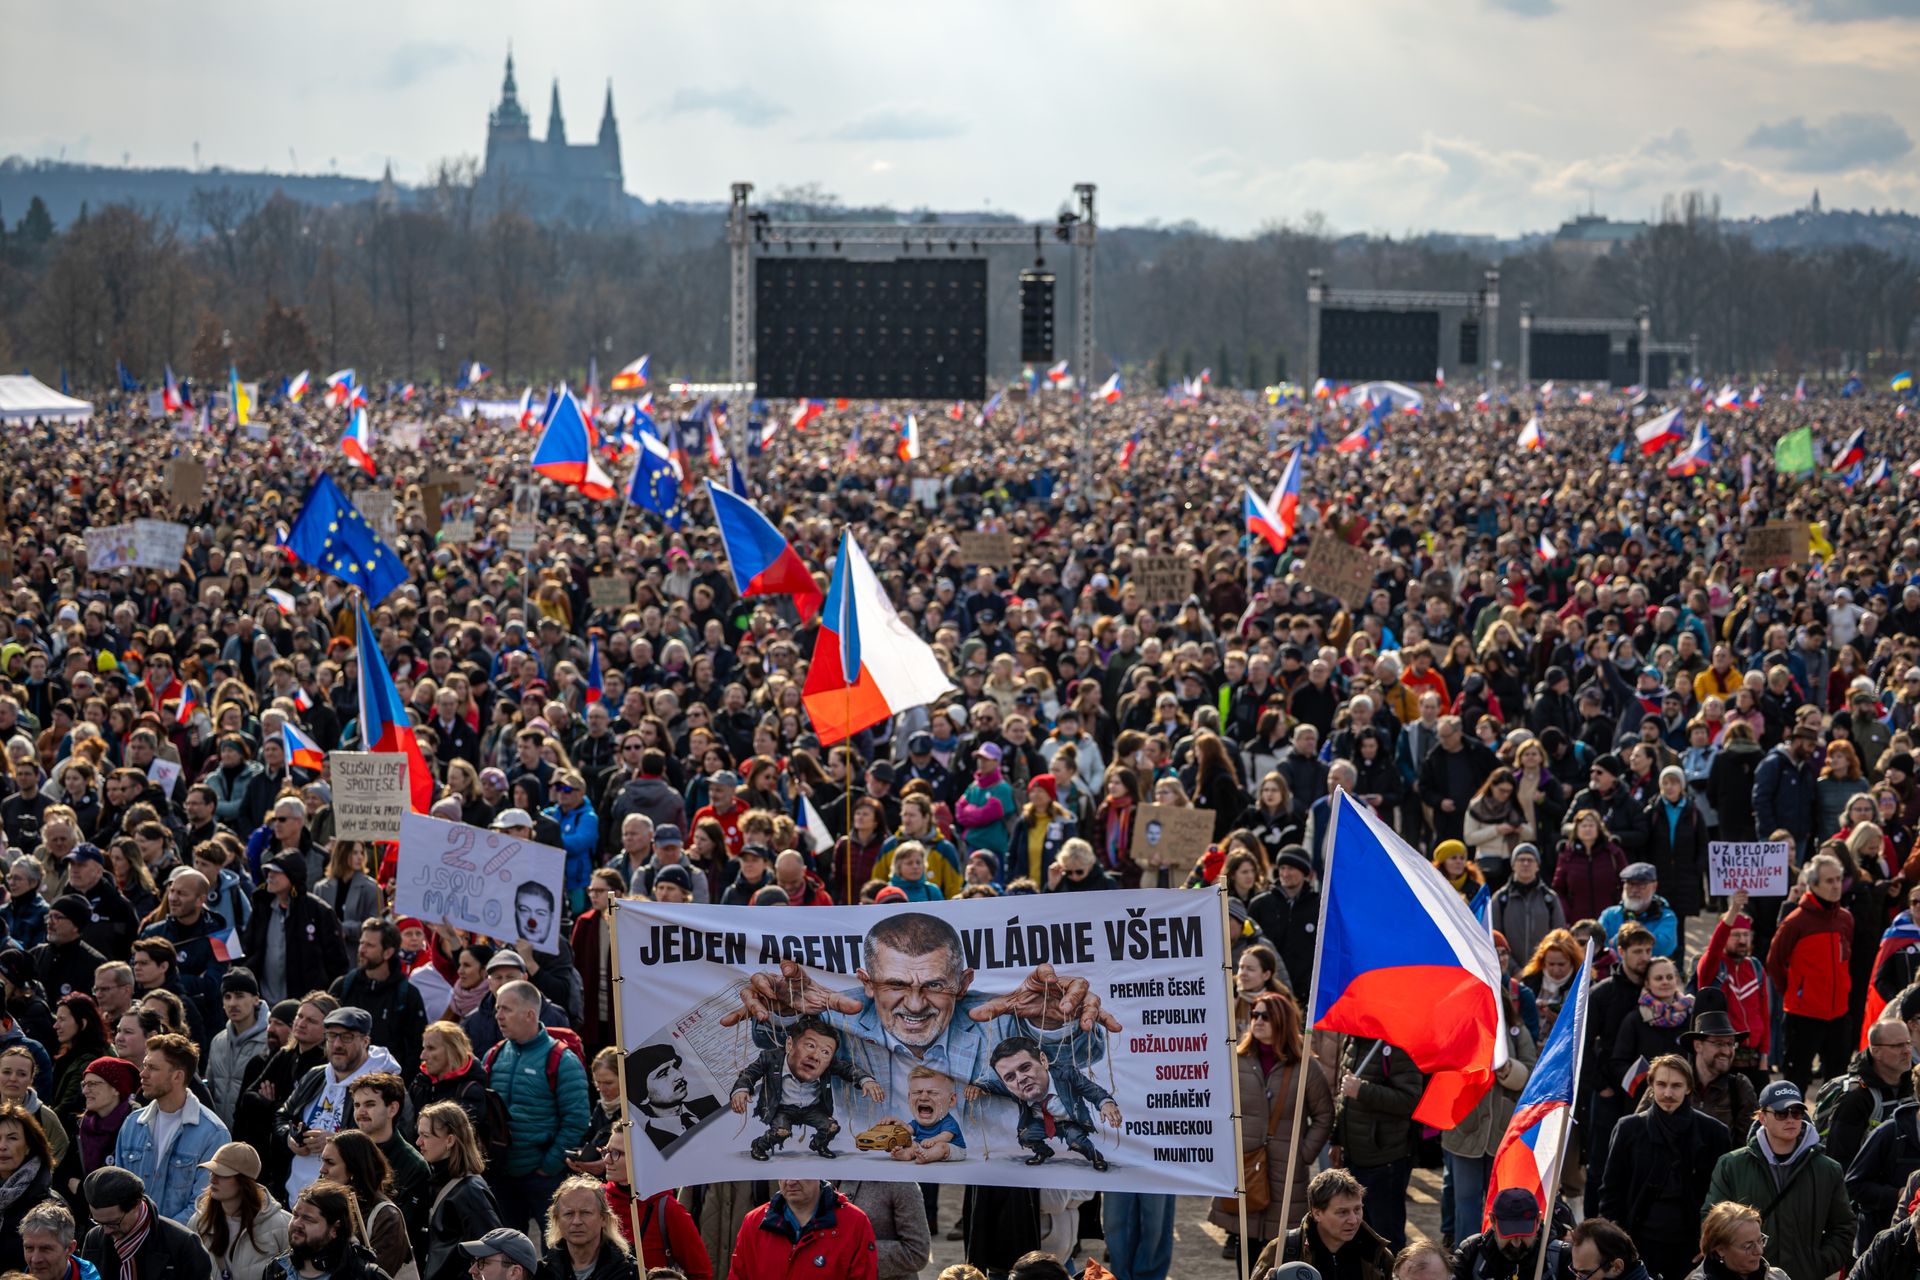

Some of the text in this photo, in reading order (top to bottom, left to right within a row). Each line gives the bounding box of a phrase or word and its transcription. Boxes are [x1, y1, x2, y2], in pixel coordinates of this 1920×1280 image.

[1735, 844, 1761, 855] BYLO
[1764, 843, 1786, 854] DOST
[412, 865, 485, 897] JSOU
[1723, 877, 1769, 889] HRANIC
[640, 908, 1203, 974] JEDEN AGENT VLÁDNE VŠEM
[1110, 977, 1206, 998] PREMIÉR ČESKÉ
[1142, 1008, 1206, 1025] REPUBLIKY
[1130, 1033, 1208, 1053] OBŽALOVANÝ
[1155, 1060, 1209, 1080] SOUZENÝ
[1146, 1089, 1211, 1109] CHRÁNĚNÝ
[1775, 1088, 1800, 1097] adidas
[1125, 1120, 1212, 1136] POSLANECKOU
[1153, 1147, 1213, 1163] IMUNITOU
